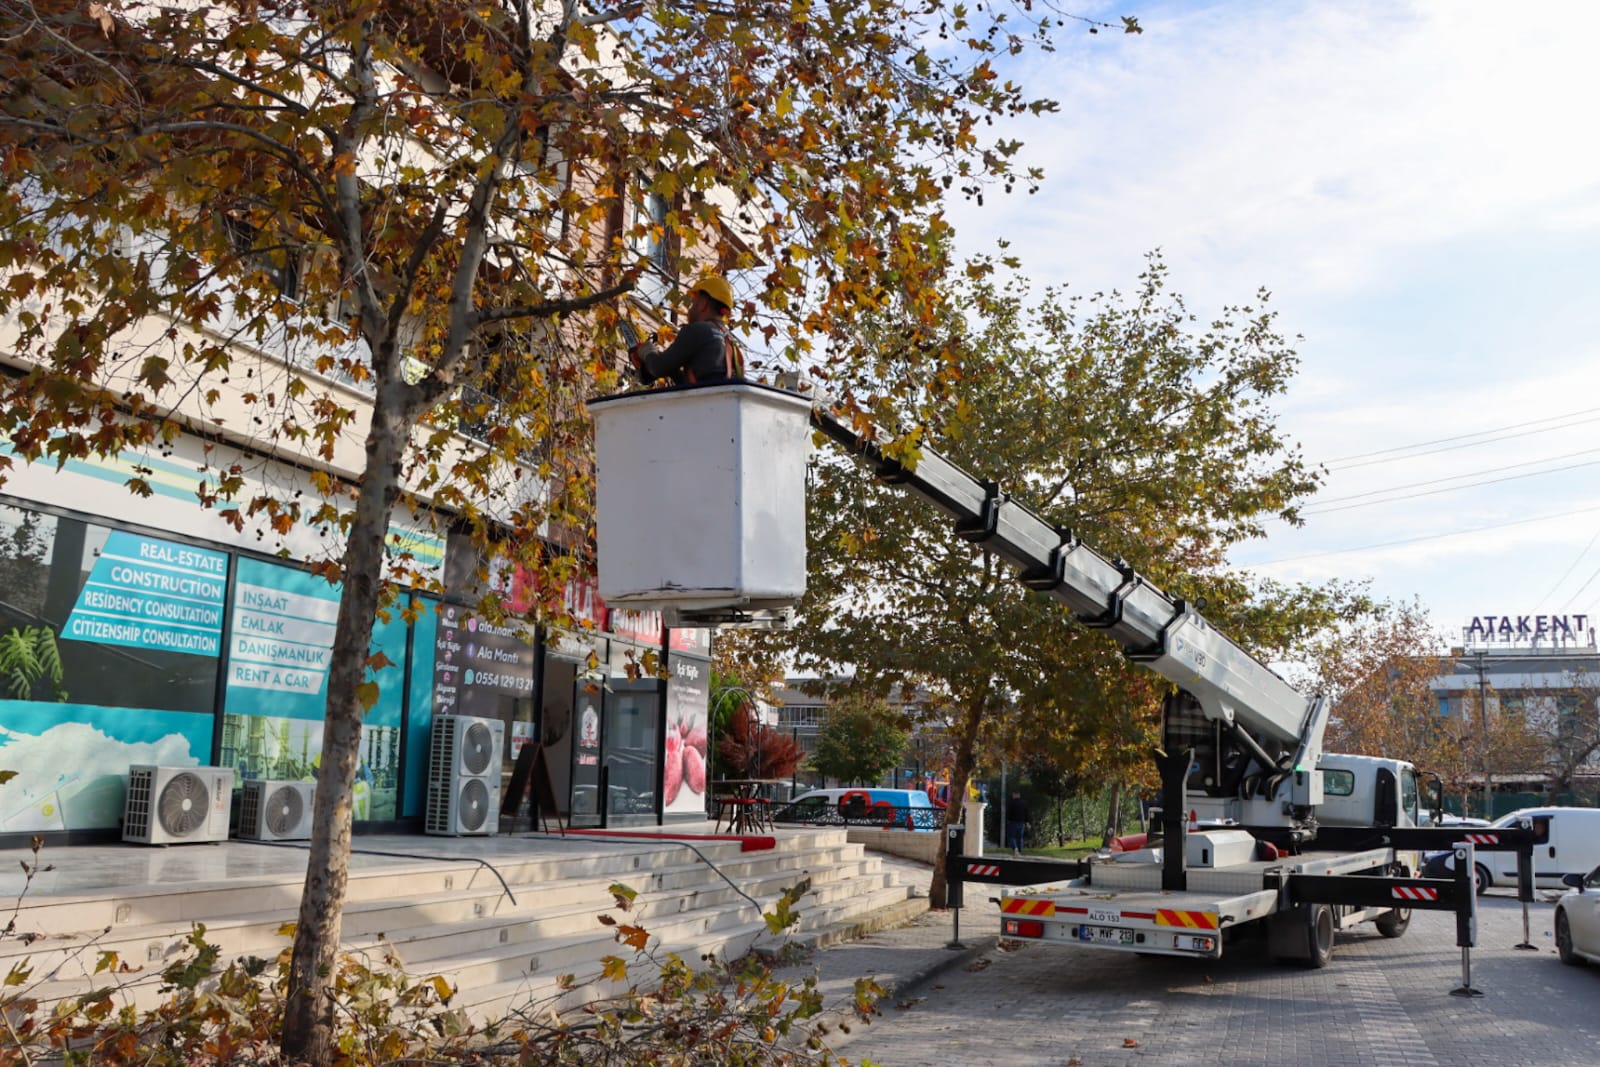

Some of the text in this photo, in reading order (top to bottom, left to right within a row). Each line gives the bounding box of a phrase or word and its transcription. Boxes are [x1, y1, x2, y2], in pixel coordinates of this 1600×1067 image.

[140, 542, 224, 572] REAL-ESTATE
[111, 566, 221, 599] CONSTRUCTİON
[84, 590, 144, 613] RESİDENCY
[241, 615, 285, 634] EMLAK
[1469, 615, 1588, 633] ATAKENT
[238, 640, 324, 663] DANIŞMANLIK
[477, 645, 519, 663] Ala Mantı
[236, 667, 309, 688] RENT A CAR
[475, 671, 499, 686] 0554
[500, 674, 513, 688] 129
[515, 677, 524, 689] 13
[1089, 913, 1120, 923] ALO 153
